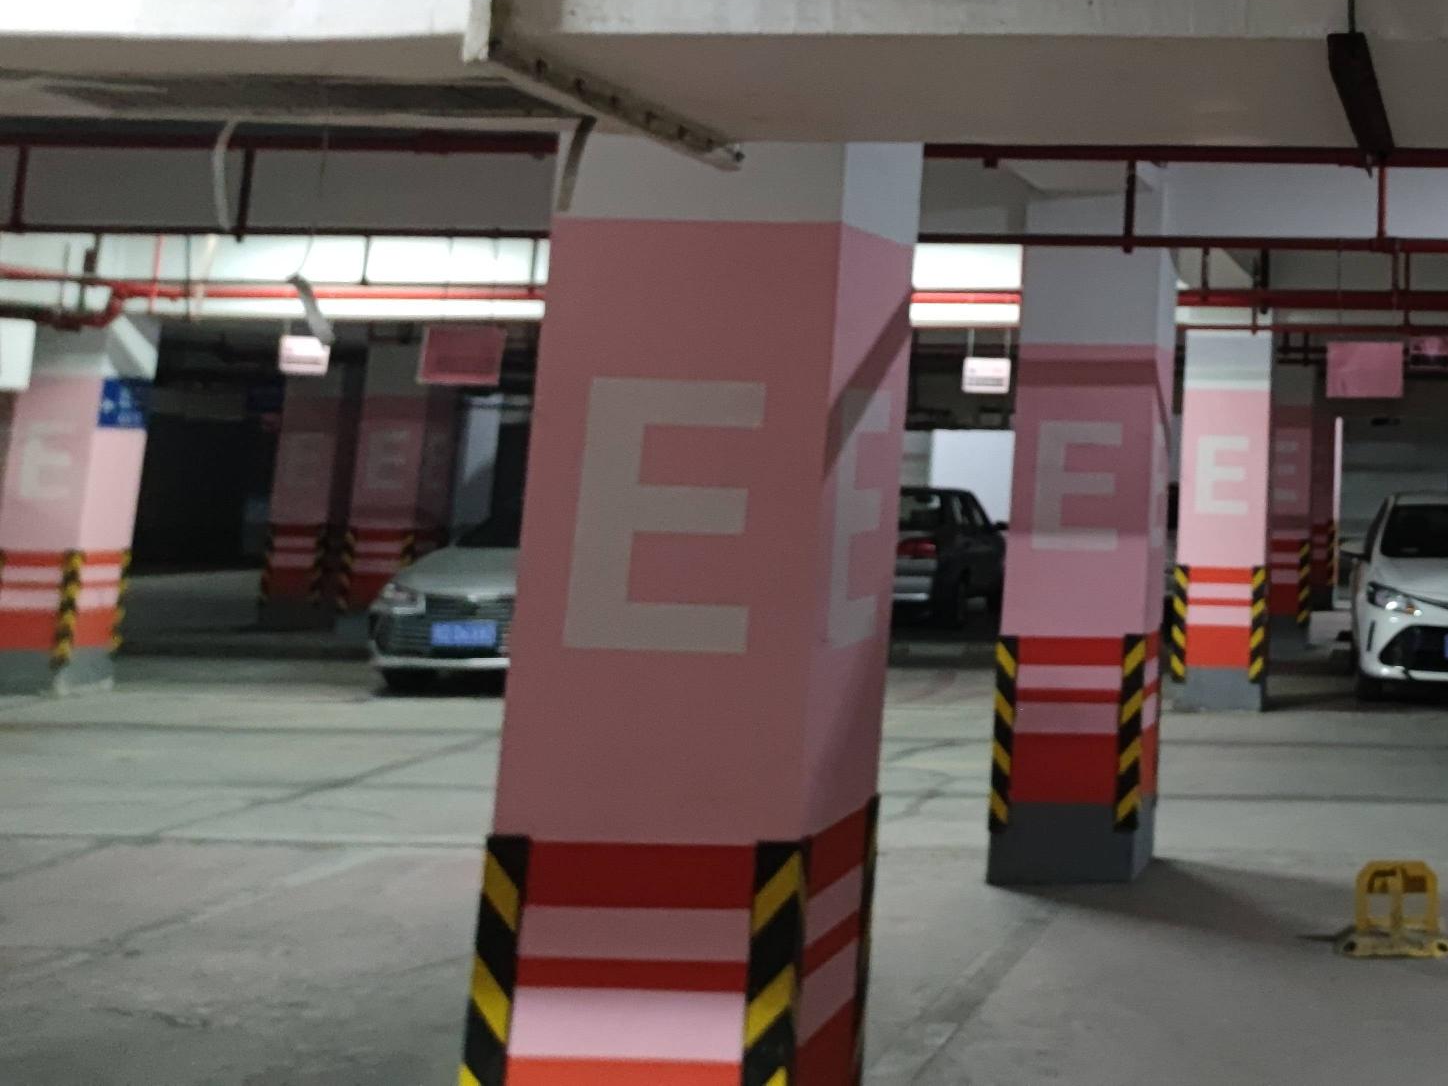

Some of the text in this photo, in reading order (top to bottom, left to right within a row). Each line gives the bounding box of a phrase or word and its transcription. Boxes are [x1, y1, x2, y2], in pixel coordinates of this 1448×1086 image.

[563, 377, 766, 654] E
[825, 388, 891, 650] E
[1032, 420, 1123, 550] E
[1195, 435, 1249, 515] E
